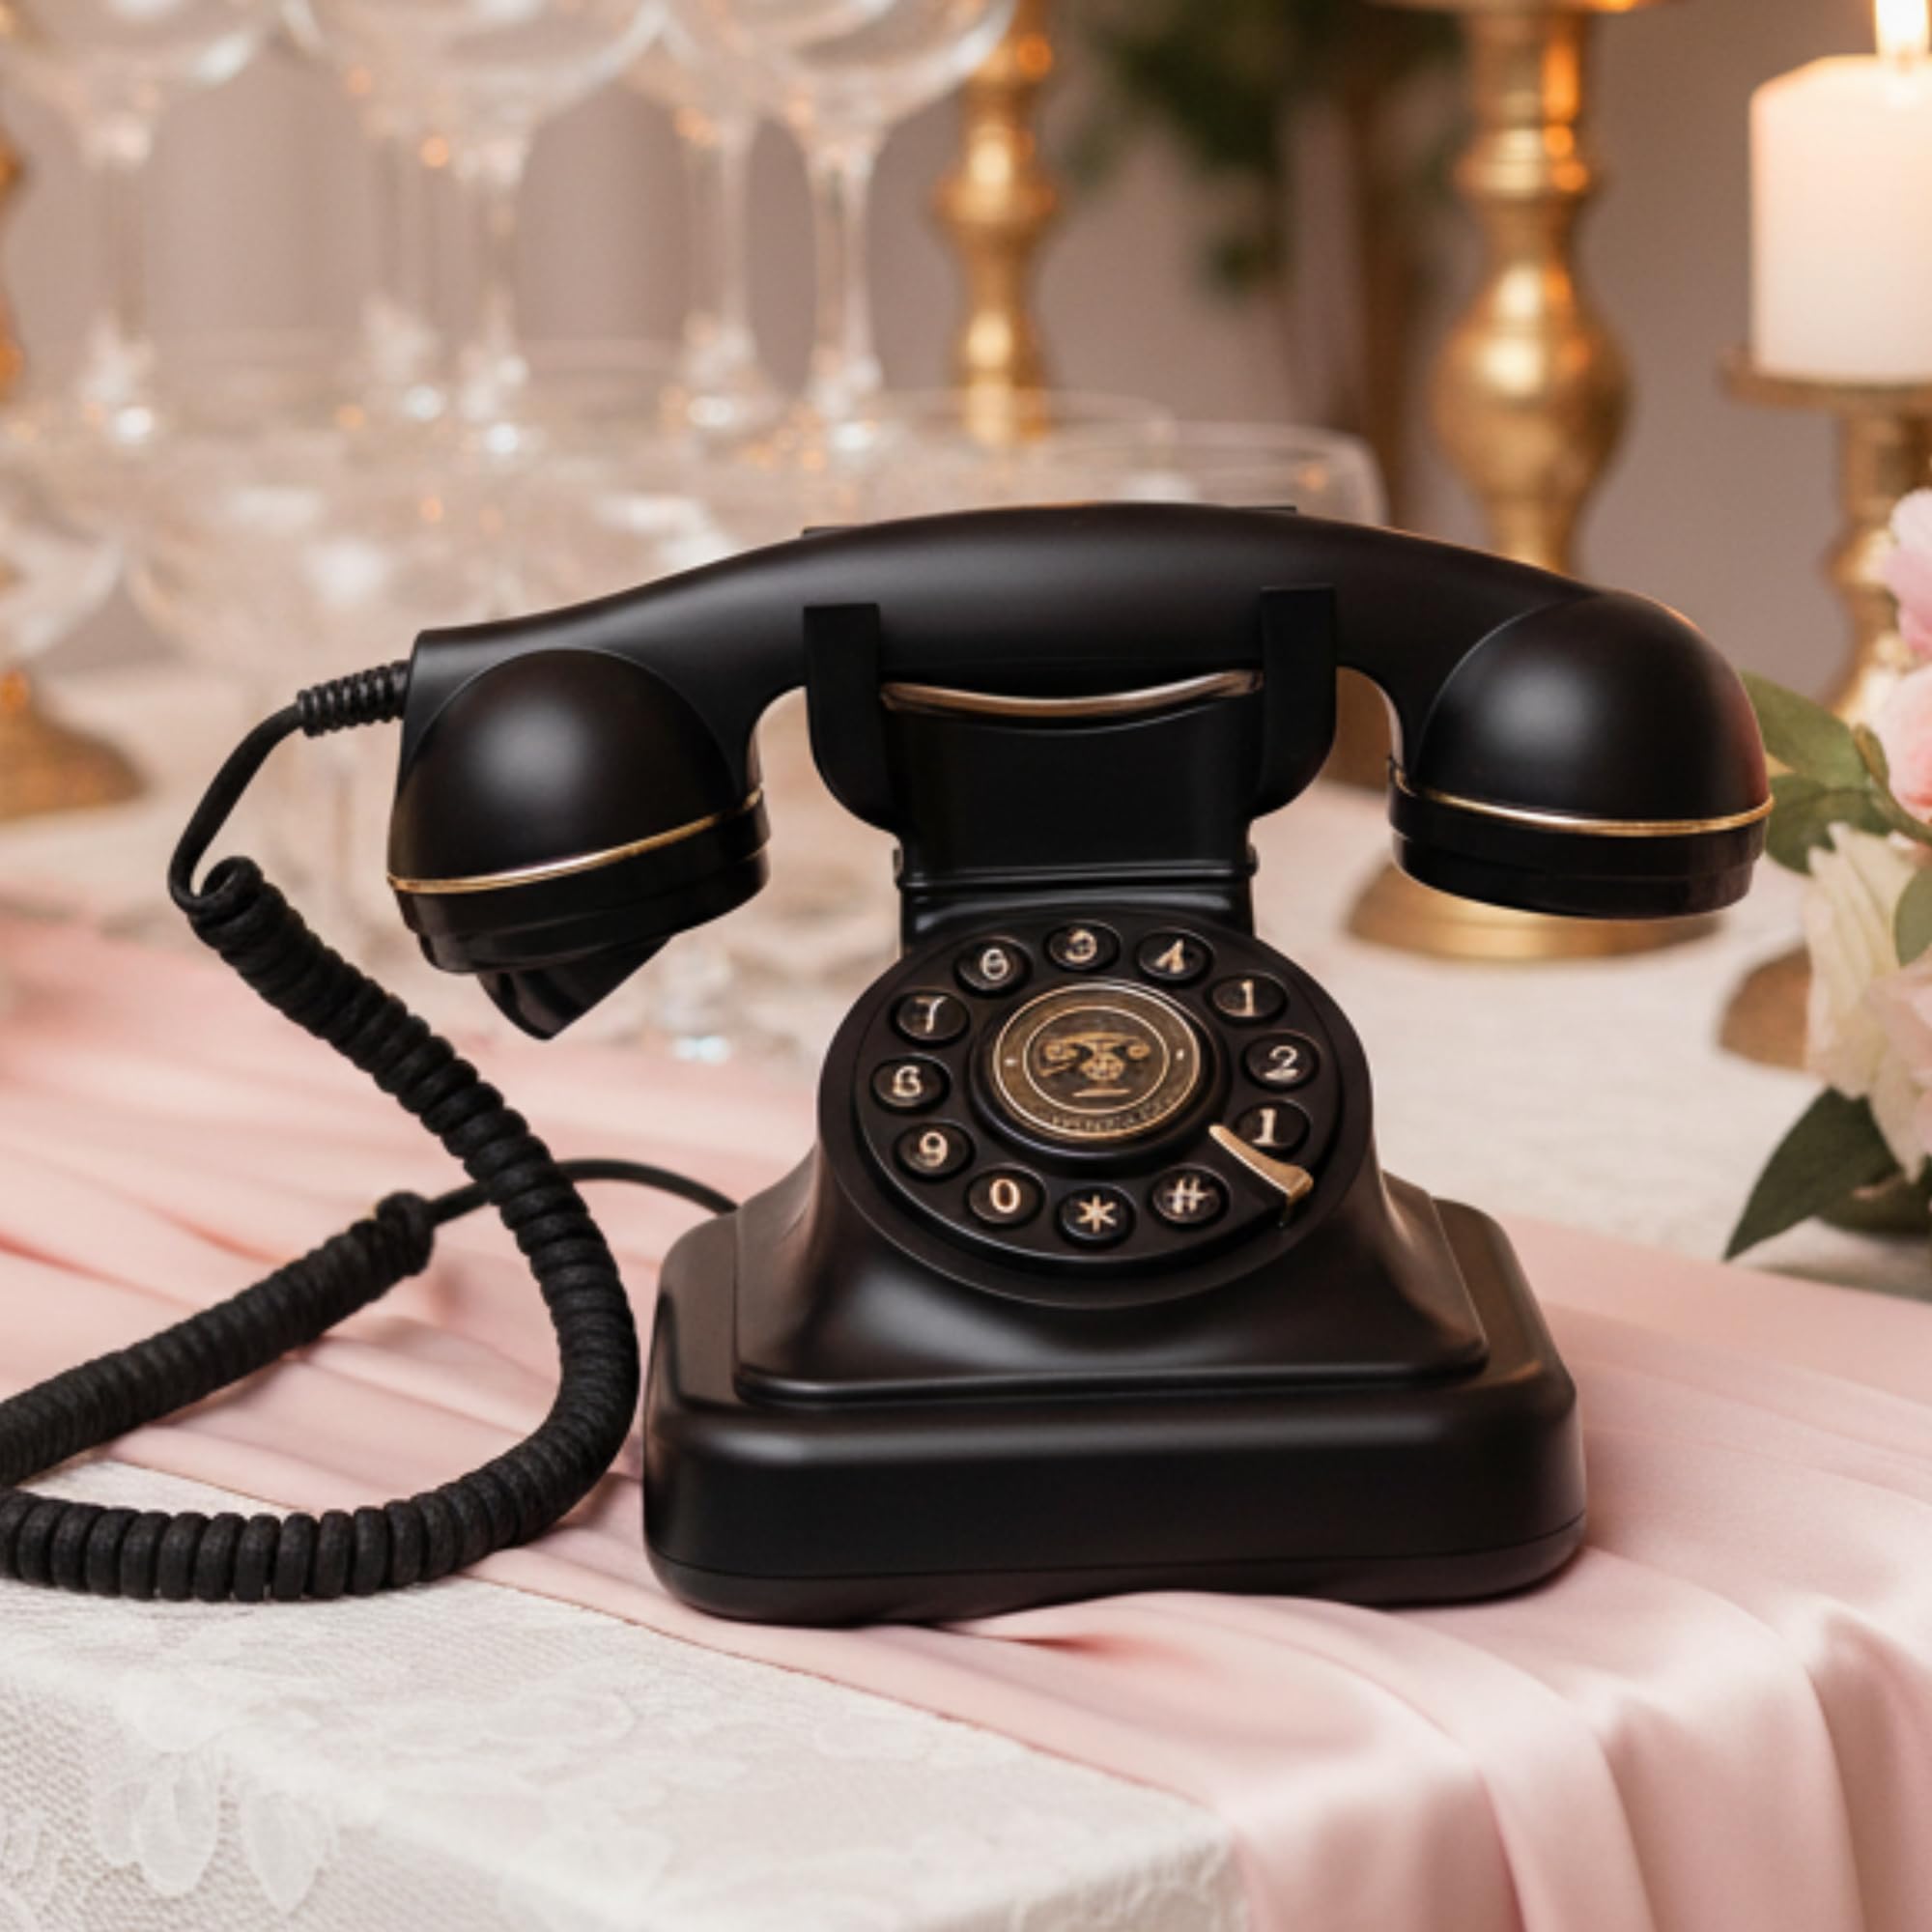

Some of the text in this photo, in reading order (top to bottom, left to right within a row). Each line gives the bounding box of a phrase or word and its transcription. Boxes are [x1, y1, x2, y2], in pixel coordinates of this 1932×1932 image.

[916, 996, 946, 1033] 7
[1236, 980, 1255, 1017] 1
[1265, 1046, 1297, 1080] 2
[1251, 1108, 1278, 1146] 1
[919, 1131, 948, 1168] 9
[989, 1179, 1021, 1214] 0
